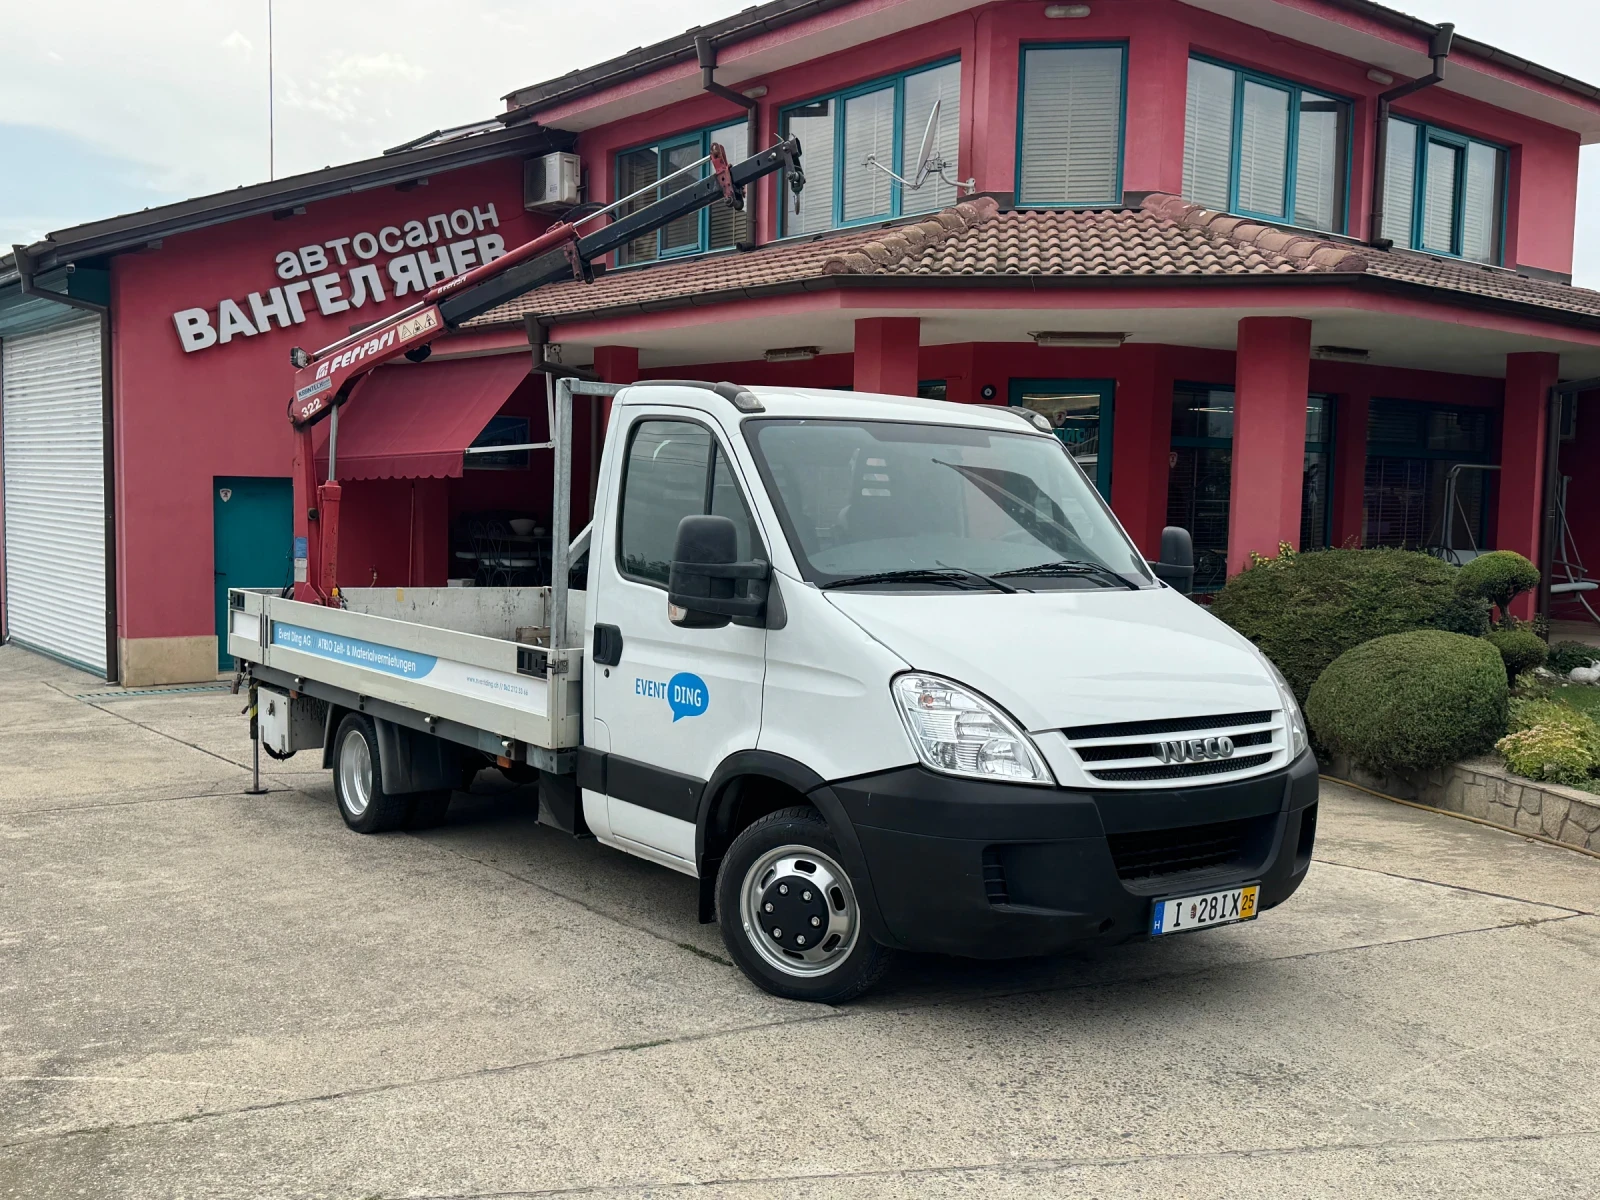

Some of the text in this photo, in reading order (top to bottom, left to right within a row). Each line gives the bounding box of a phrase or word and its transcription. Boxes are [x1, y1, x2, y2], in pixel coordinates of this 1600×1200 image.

[275, 203, 499, 280] автосалон
[173, 264, 386, 353] ВАНГЕЛ
[330, 328, 396, 374] Ferrari
[301, 398, 322, 418] 322
[278, 628, 291, 641] Event
[291, 631, 303, 647] Ding
[303, 634, 312, 646] AG
[352, 646, 416, 673] Materialvermietungen
[635, 678, 702, 707] EVENT DING
[1157, 736, 1235, 764] IVECO
[1154, 921, 1160, 930] H
[1241, 893, 1255, 911] 25
